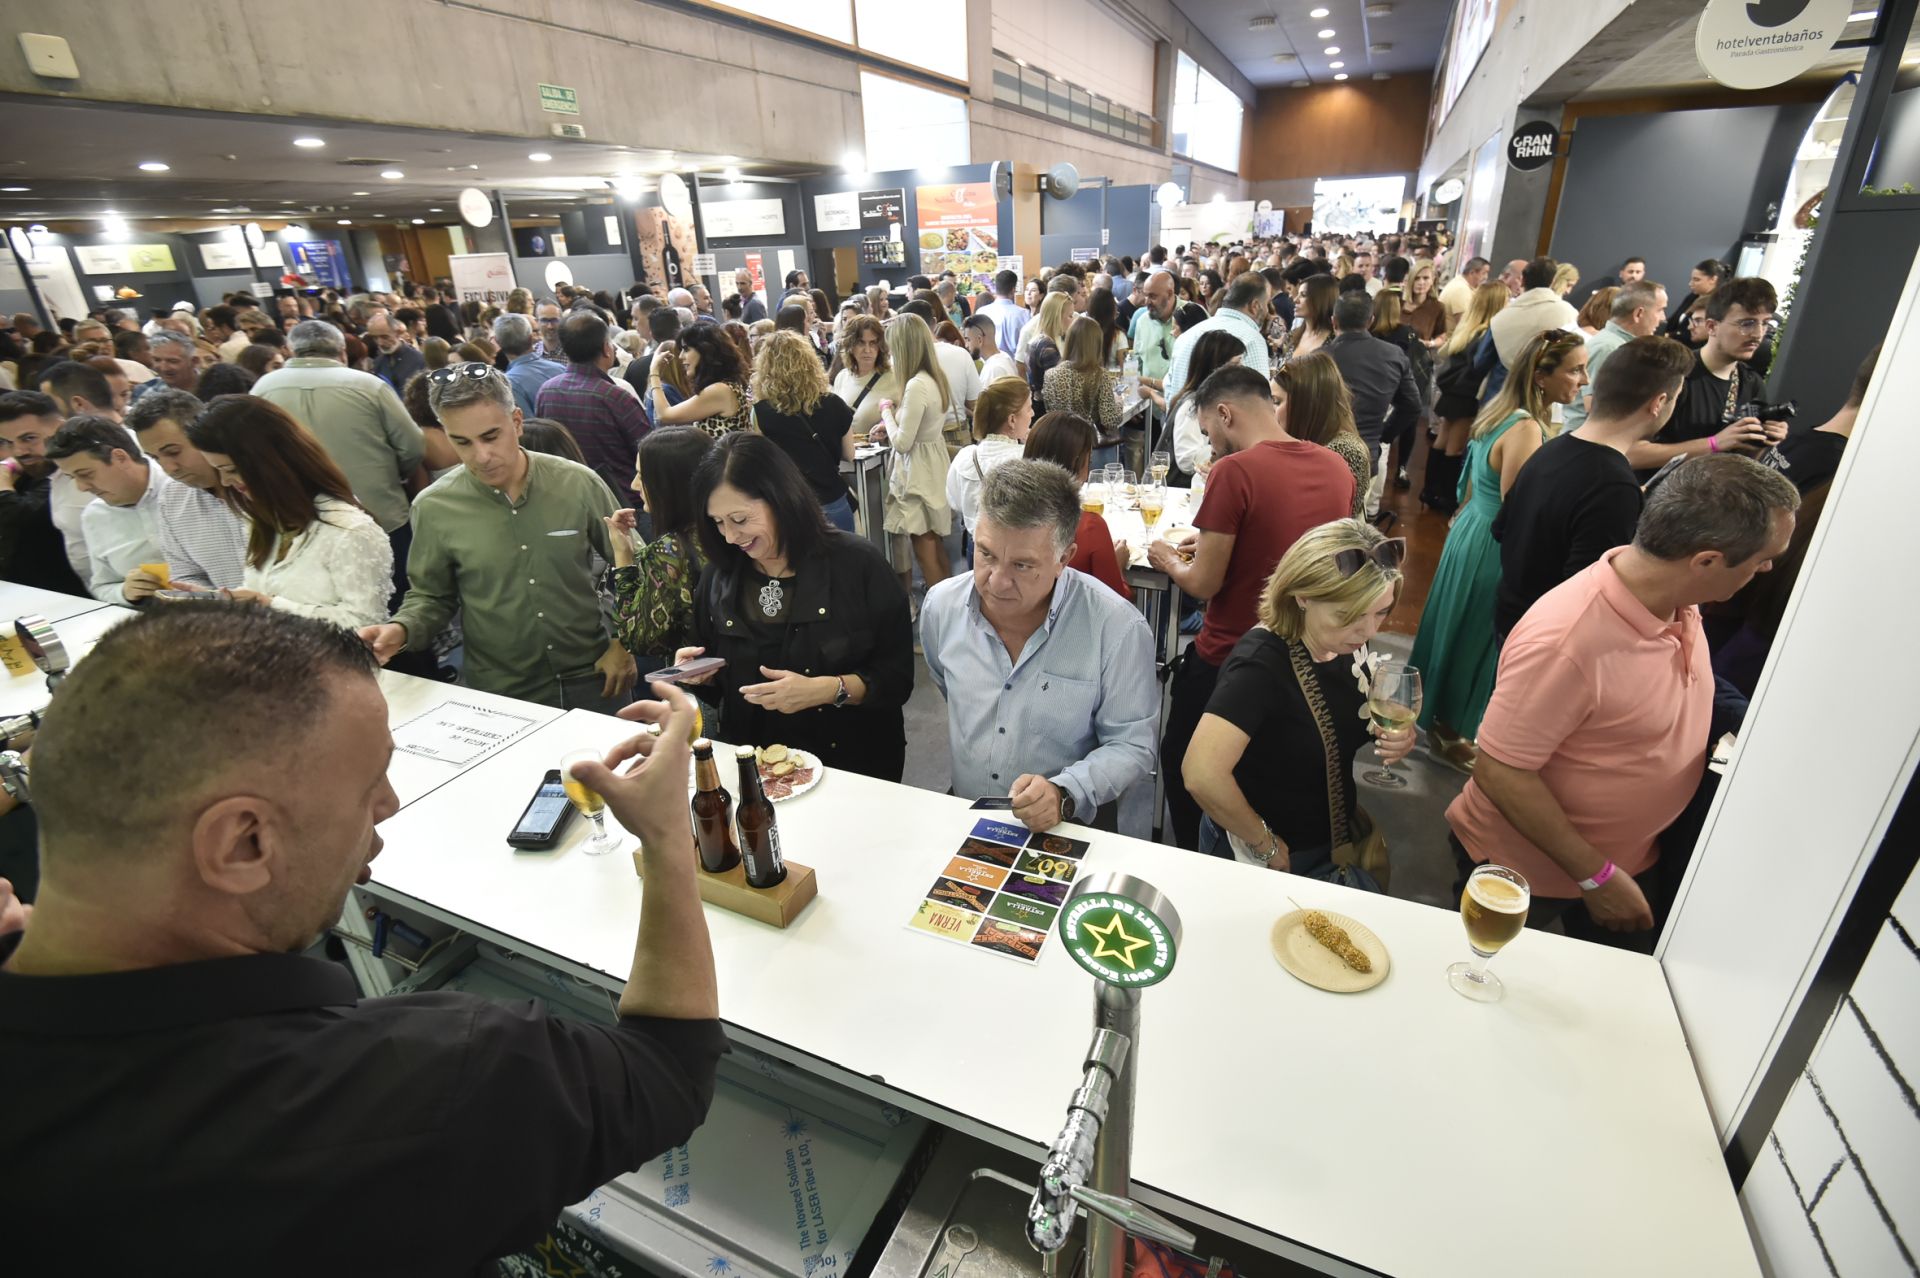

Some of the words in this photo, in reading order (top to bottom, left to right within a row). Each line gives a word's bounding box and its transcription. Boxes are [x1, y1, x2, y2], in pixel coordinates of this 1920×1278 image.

[1513, 133, 1553, 148] GRAN
[1516, 144, 1553, 158] RHIN.
[1006, 901, 1045, 916] ESTRELLA
[1112, 899, 1135, 915] DE
[928, 911, 963, 933] VERNA
[678, 1163, 690, 1177] for
[785, 1148, 799, 1188] Solution
[801, 1158, 812, 1166] &
[663, 1163, 674, 1181] The
[804, 1167, 817, 1192] Fiber
[790, 1188, 808, 1229] Novacel
[808, 1192, 824, 1228] LASER
[800, 1229, 811, 1251] The
[816, 1229, 828, 1245] for
